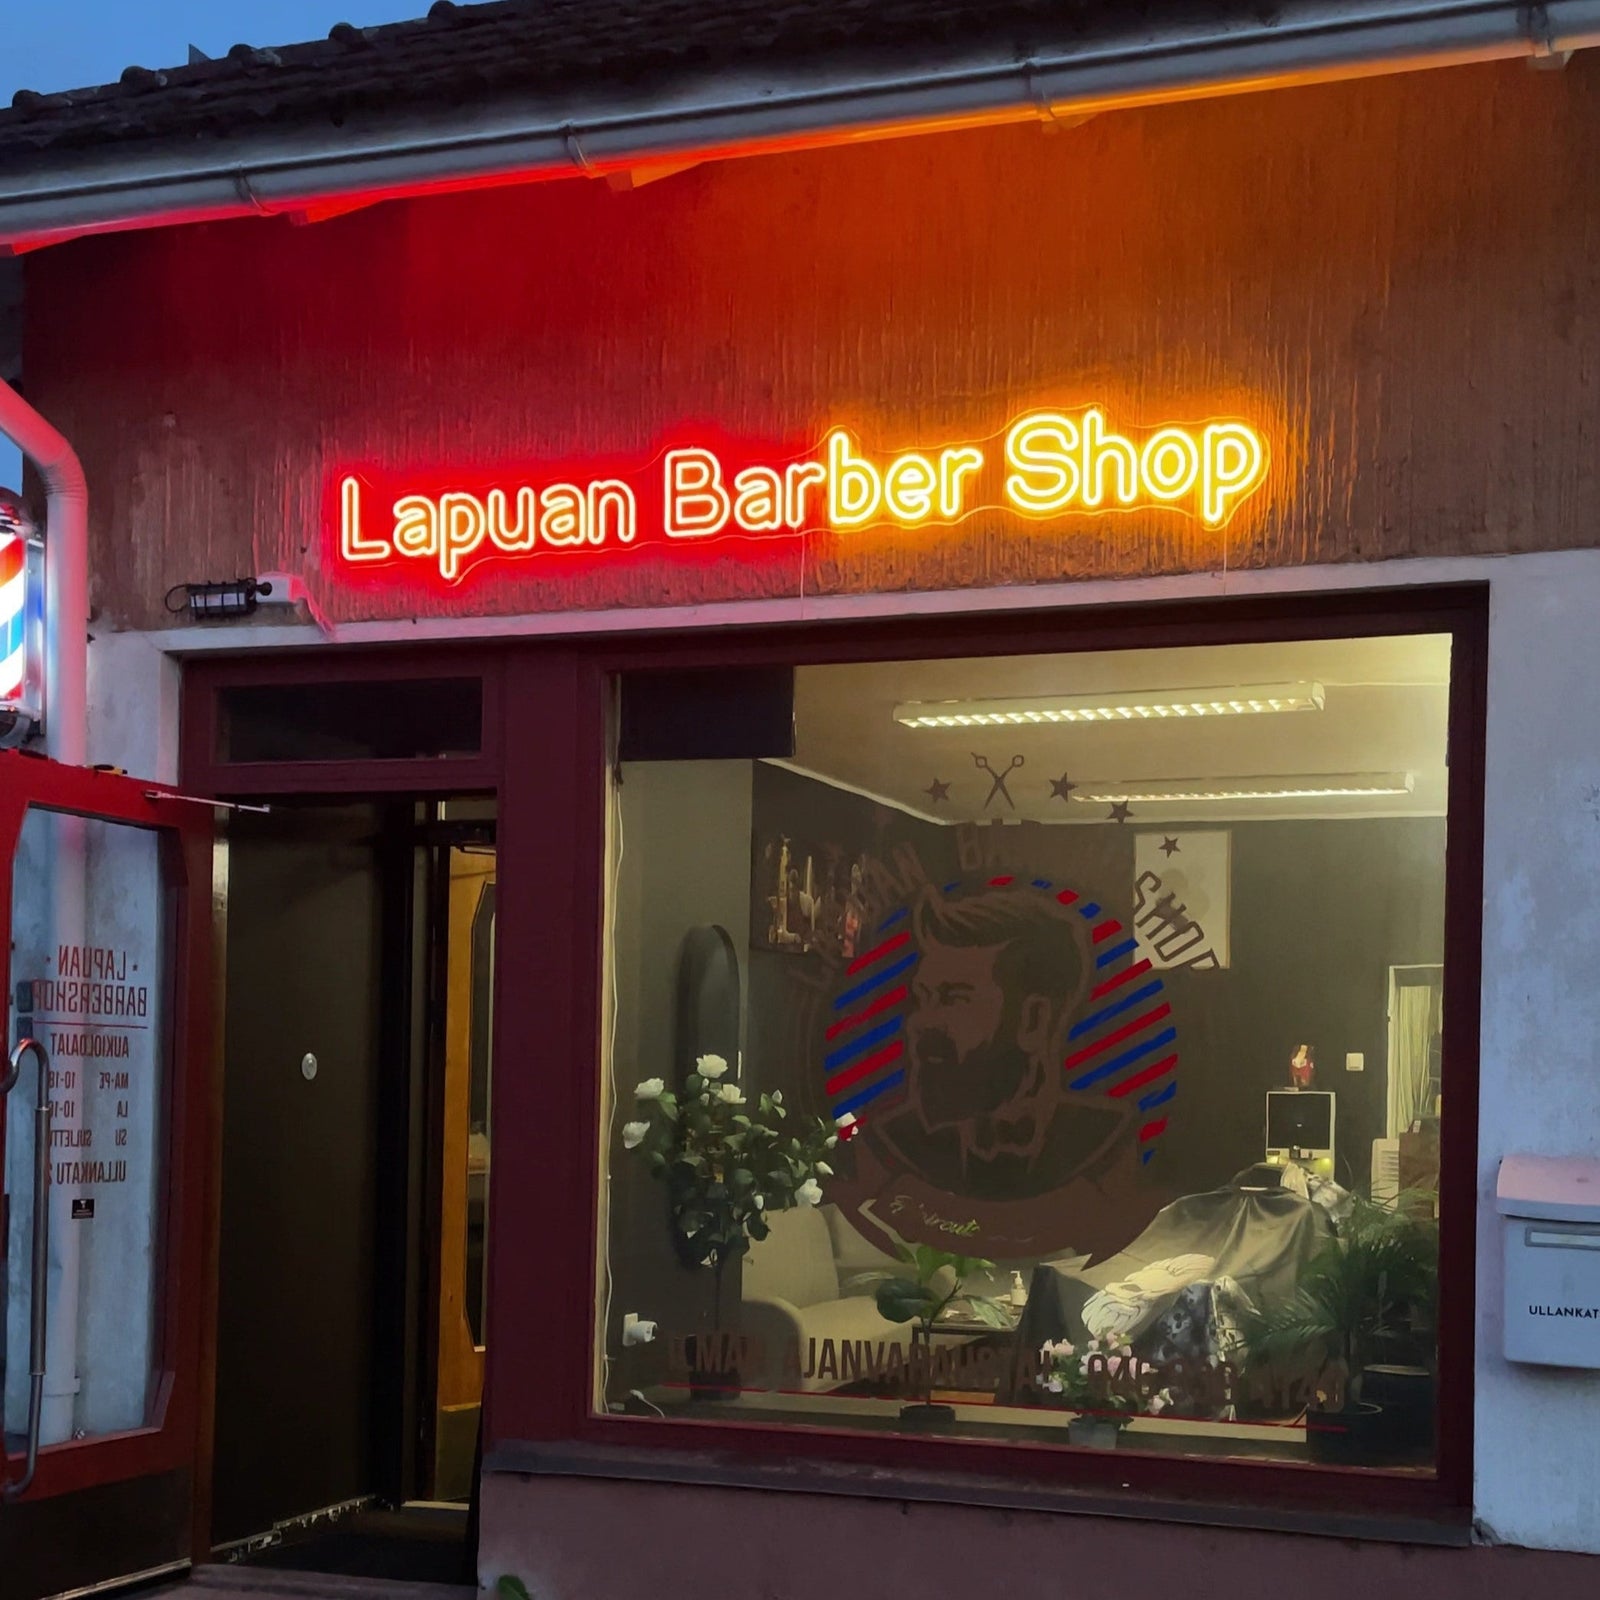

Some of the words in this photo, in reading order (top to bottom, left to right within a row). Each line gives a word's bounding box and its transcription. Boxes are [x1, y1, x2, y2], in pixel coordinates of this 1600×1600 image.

[341, 476, 637, 579] Lapuan
[663, 431, 984, 538] Barber
[1005, 409, 1262, 523] Shop
[1528, 1304, 1600, 1320] ULLANKAT
